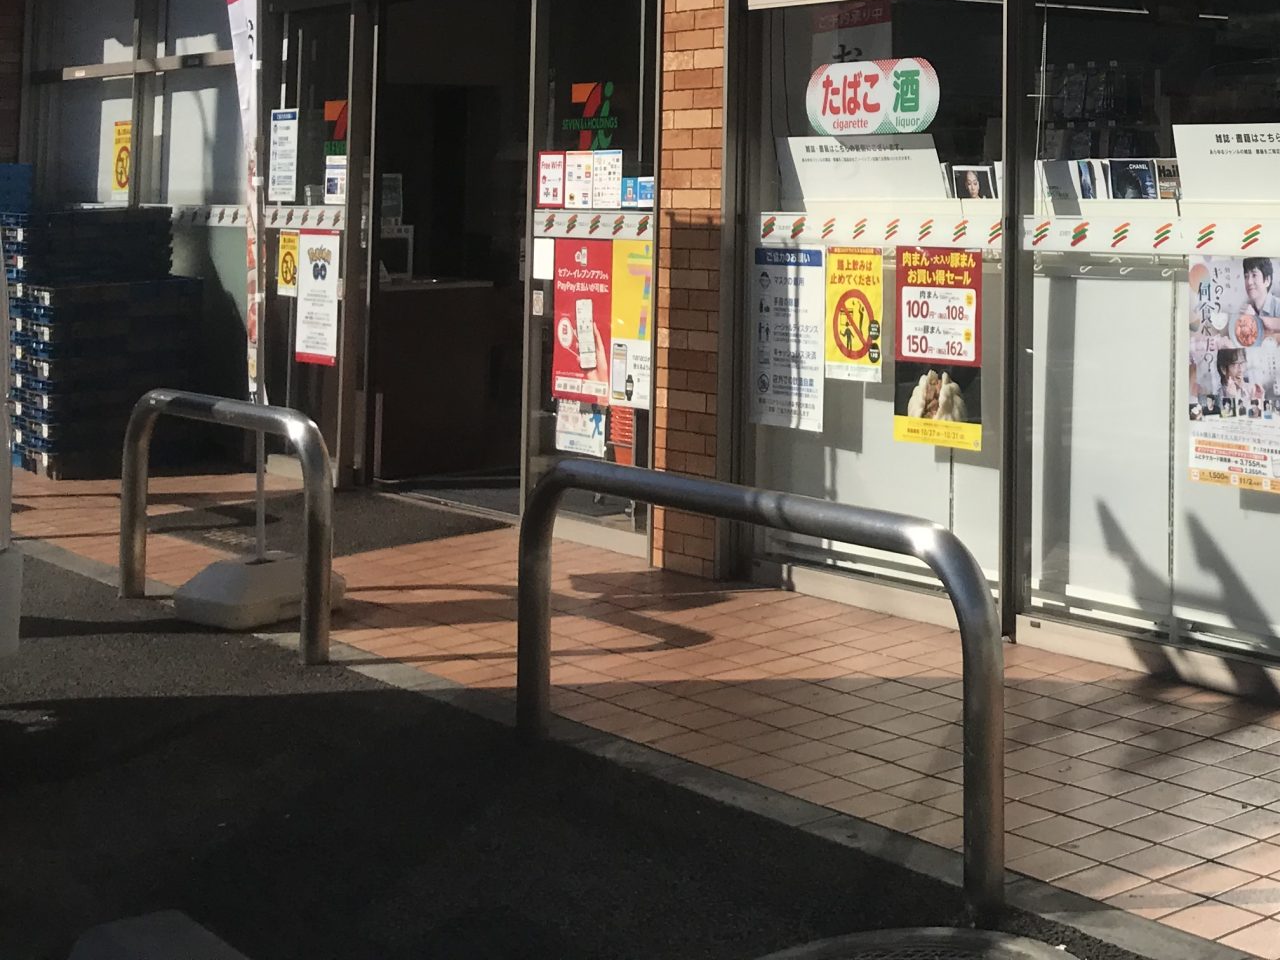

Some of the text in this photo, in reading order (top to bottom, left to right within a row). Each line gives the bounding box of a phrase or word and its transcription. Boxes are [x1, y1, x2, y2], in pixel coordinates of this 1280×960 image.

[821, 69, 921, 116] たばこ 酒
[832, 115, 921, 131] cigarette liquor
[313, 263, 327, 280] GO
[829, 274, 880, 286] 止めてください
[907, 268, 972, 286] お買い得セール
